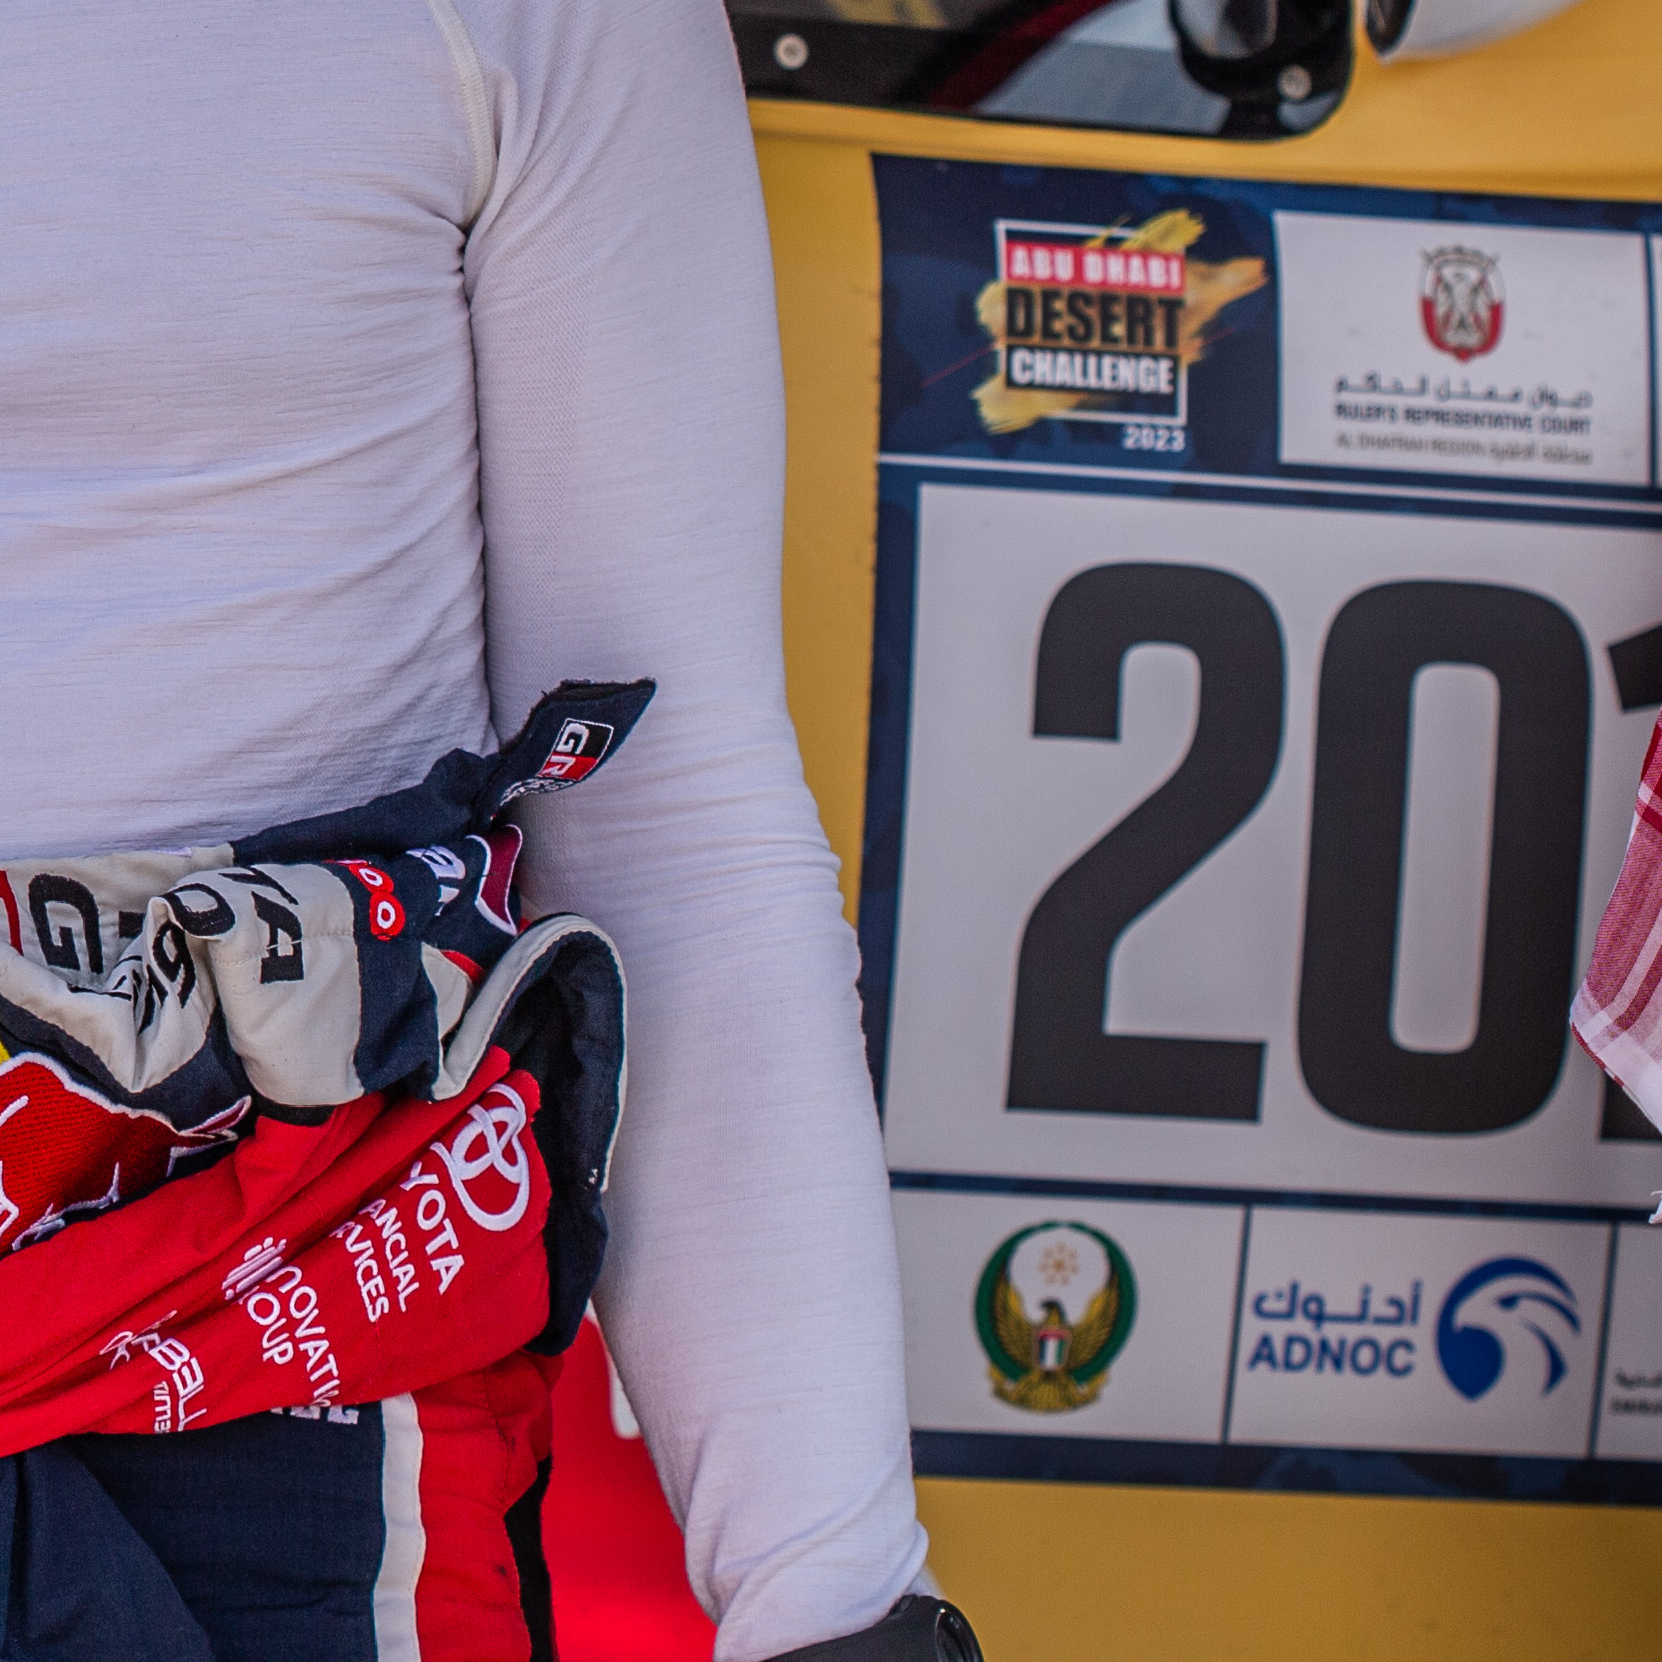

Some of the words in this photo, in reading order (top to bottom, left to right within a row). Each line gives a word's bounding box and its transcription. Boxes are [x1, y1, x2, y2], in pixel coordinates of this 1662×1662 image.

[1009, 245, 1075, 282] ABU
[1081, 252, 1182, 289] DHABI
[1006, 287, 1186, 348] DESERT
[1010, 347, 1175, 394] CHALLENGE
[1124, 425, 1186, 452] 2023
[1539, 415, 1591, 436] COURT
[399, 1161, 465, 1295] YOTA
[1247, 1333, 1417, 1378] ADNOC
